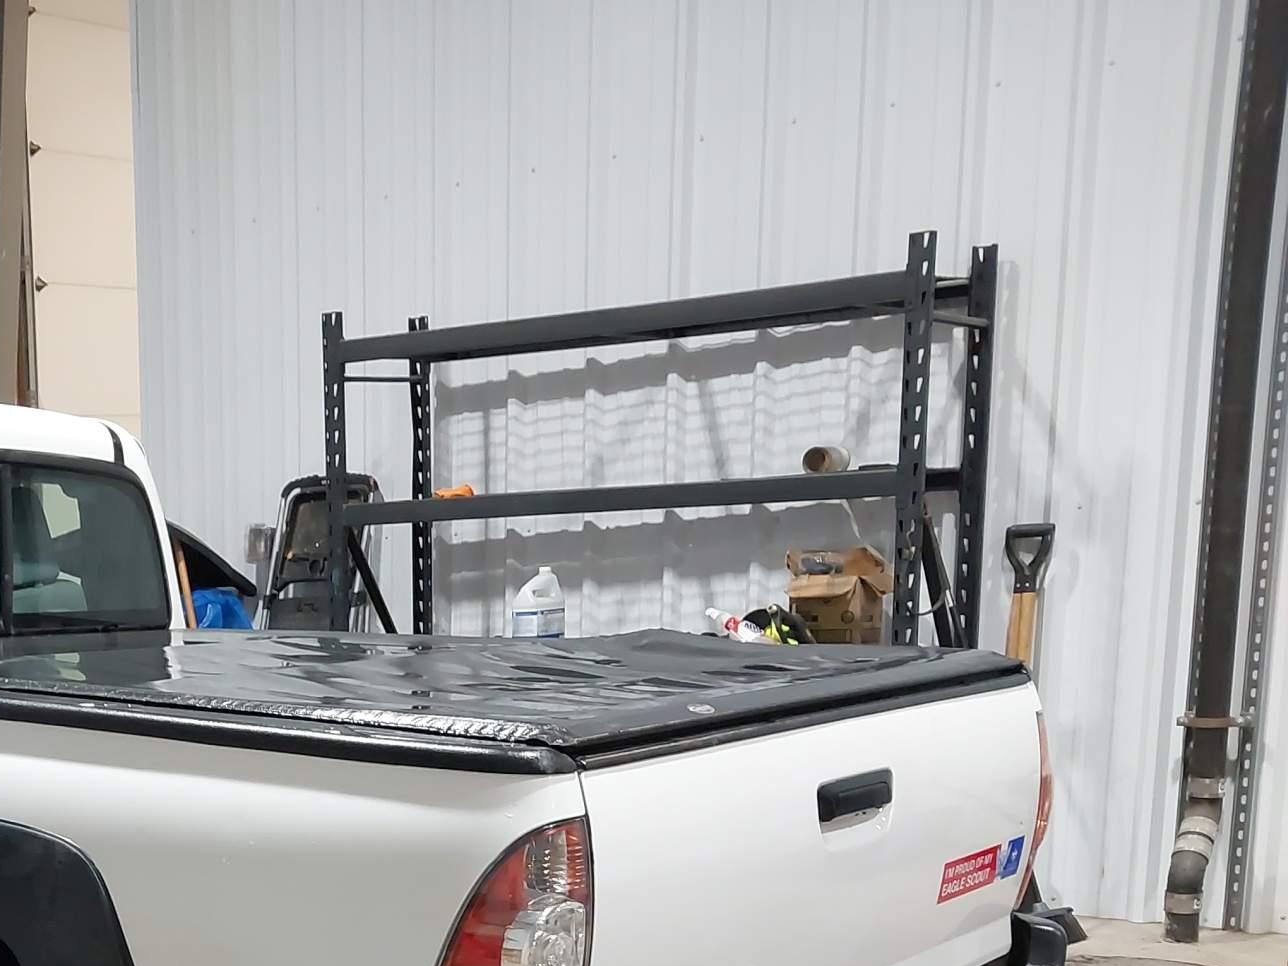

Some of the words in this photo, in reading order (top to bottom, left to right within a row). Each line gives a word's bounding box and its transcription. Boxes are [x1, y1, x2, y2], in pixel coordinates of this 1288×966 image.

[955, 860, 975, 875] PROUD
[941, 877, 966, 897] EAGLE
[966, 868, 991, 887] SCOUT
